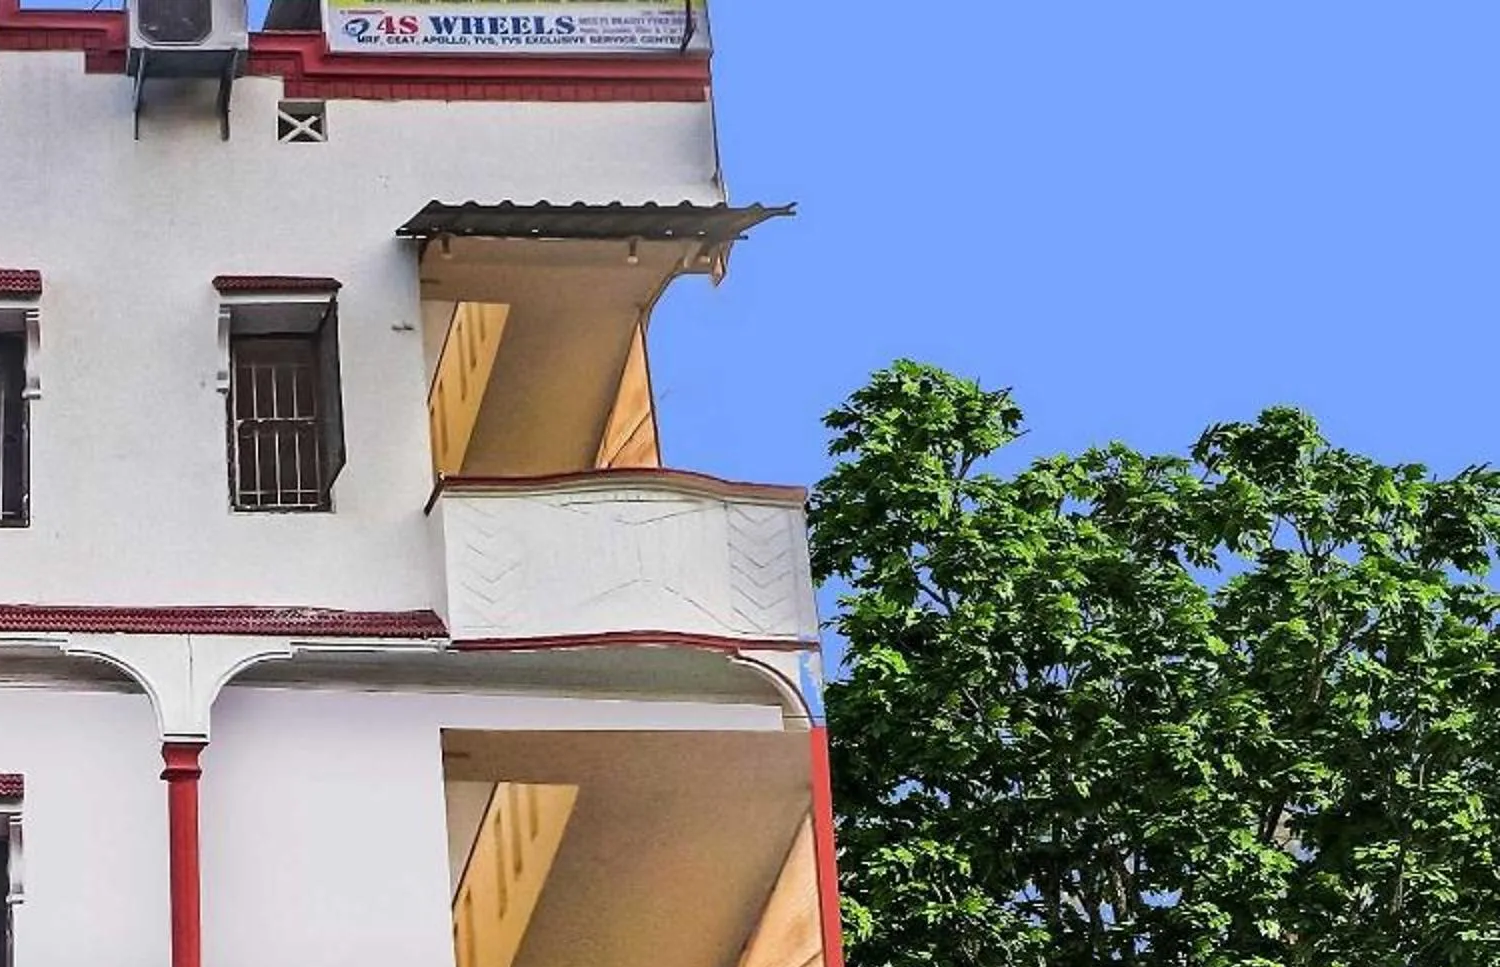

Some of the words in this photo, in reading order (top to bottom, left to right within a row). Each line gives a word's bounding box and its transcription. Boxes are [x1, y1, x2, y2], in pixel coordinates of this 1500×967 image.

[377, 16, 419, 35] 4S
[429, 16, 576, 35] WHEELS
[525, 36, 585, 45] EXCLUSIVE
[589, 36, 637, 45] SERVICE
